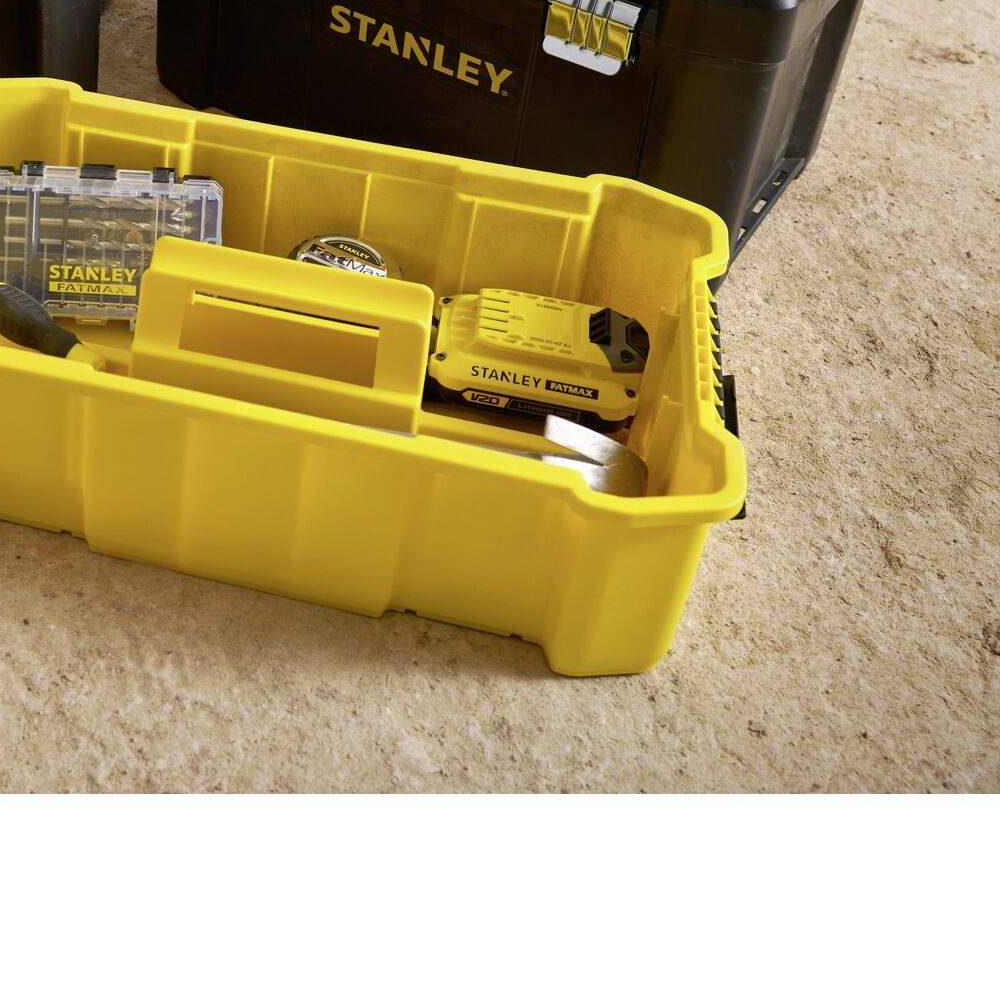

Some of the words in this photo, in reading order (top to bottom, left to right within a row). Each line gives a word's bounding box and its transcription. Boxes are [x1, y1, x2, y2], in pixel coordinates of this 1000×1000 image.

[329, 3, 513, 95] STANLEY
[309, 243, 385, 277] FatMa
[339, 243, 370, 260] STANLEY
[48, 264, 137, 284] STANLEY
[56, 283, 129, 296] FATMAX
[471, 365, 542, 389] STANLEY
[471, 393, 501, 406] V20
[549, 382, 594, 399] FATMAX
